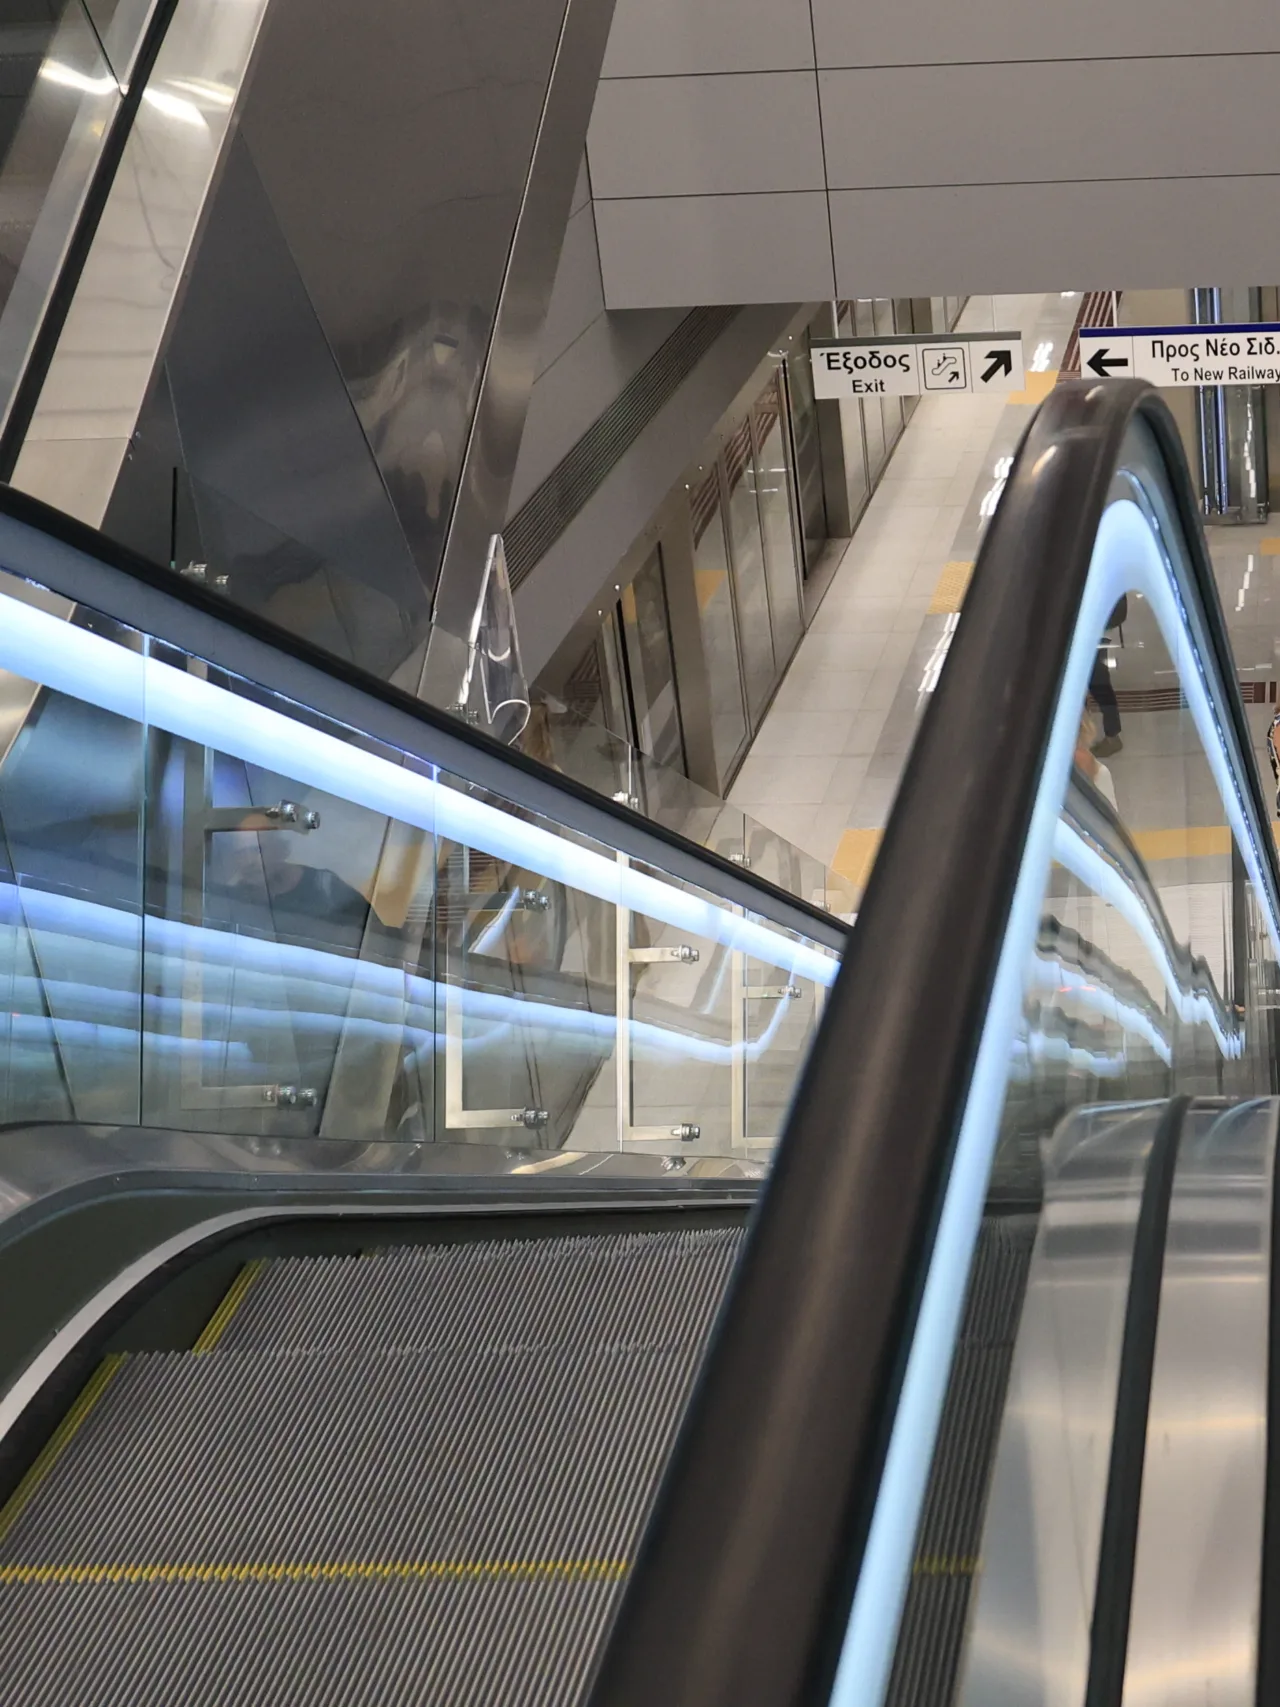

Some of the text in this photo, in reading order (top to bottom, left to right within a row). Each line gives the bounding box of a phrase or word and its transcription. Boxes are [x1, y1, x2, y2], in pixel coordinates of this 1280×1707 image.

[1152, 340, 1200, 362] Προς
[1206, 337, 1240, 357] Νέο
[1246, 337, 1280, 355] Σιδ.
[819, 351, 910, 374] Έξοδος
[1171, 368, 1189, 382] To
[1194, 367, 1223, 381] New
[852, 379, 885, 393] Exit
